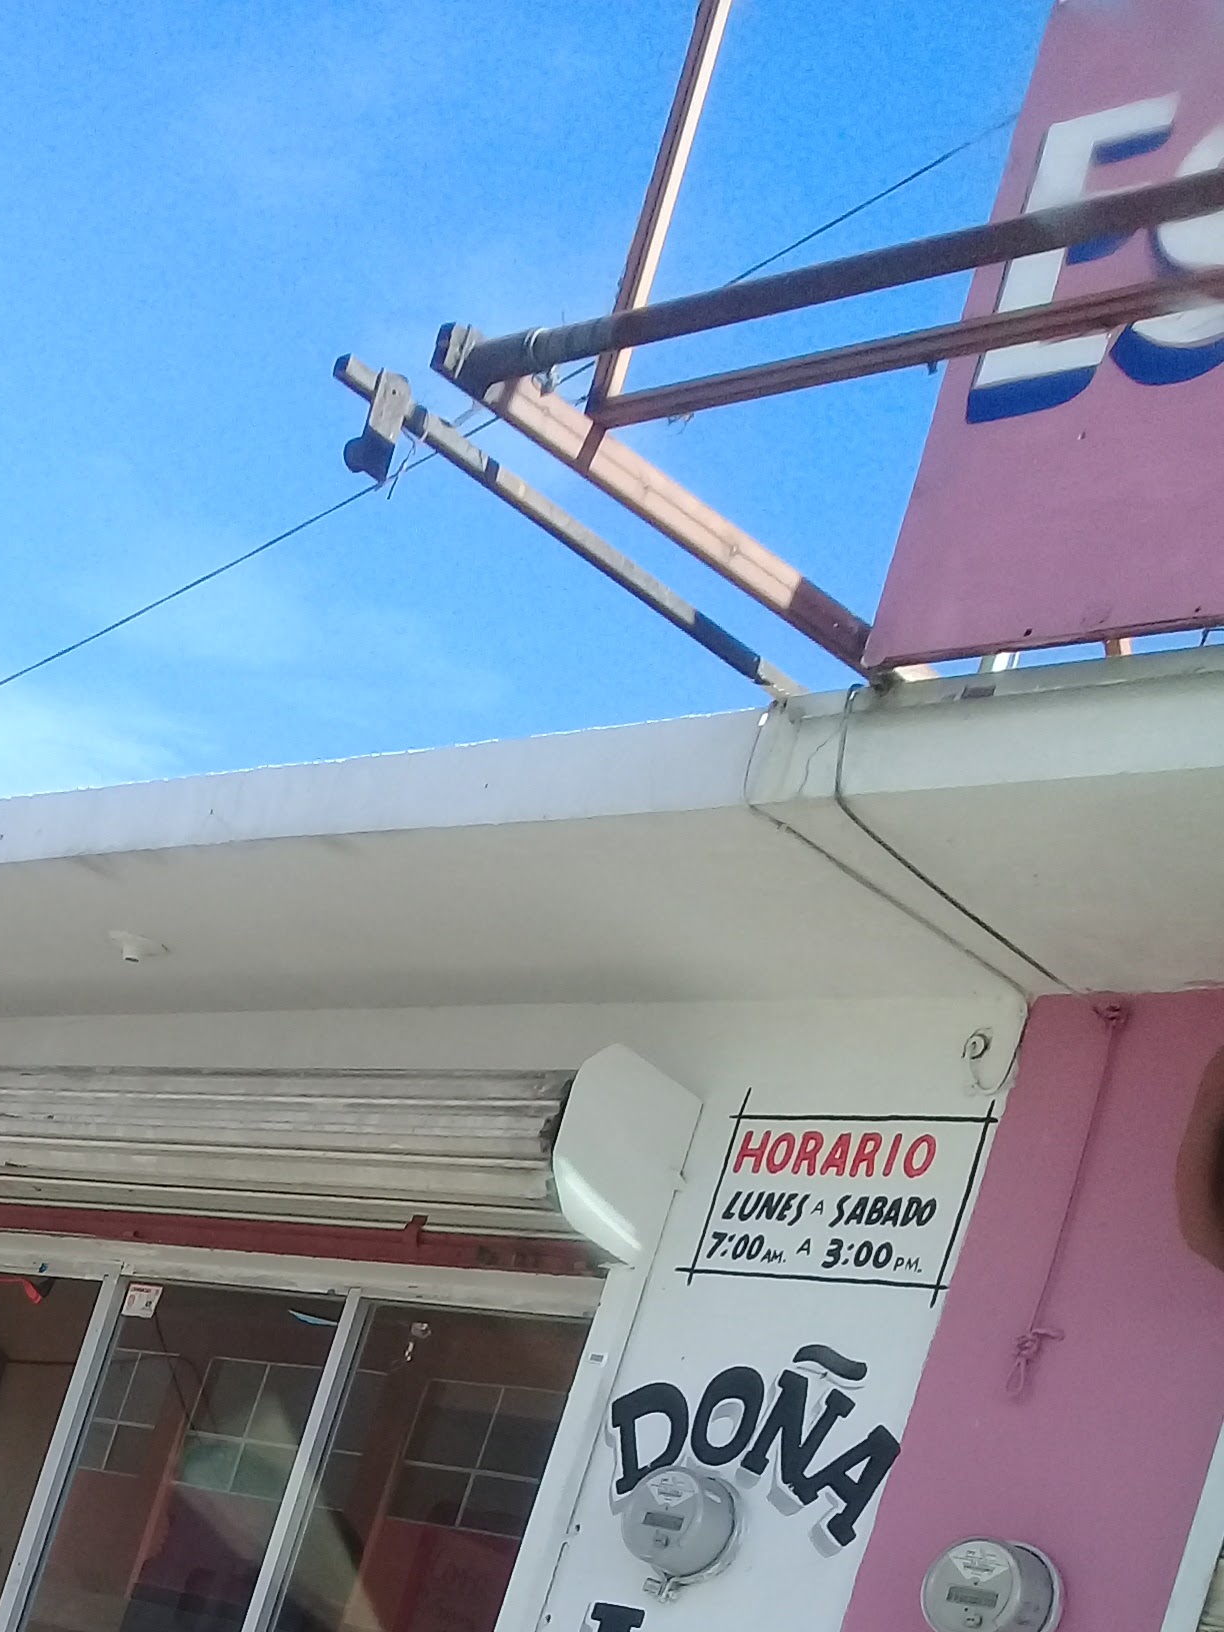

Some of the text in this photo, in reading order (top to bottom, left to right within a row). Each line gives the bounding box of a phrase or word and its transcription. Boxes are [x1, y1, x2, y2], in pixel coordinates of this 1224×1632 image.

[732, 1129, 937, 1179] HORARIO
[721, 1190, 938, 1228] LUNES A SABADO
[705, 1230, 766, 1261] 7:00
[796, 1237, 812, 1257] A
[820, 1237, 894, 1270] 3:00
[611, 1344, 903, 1547] DOÑA
